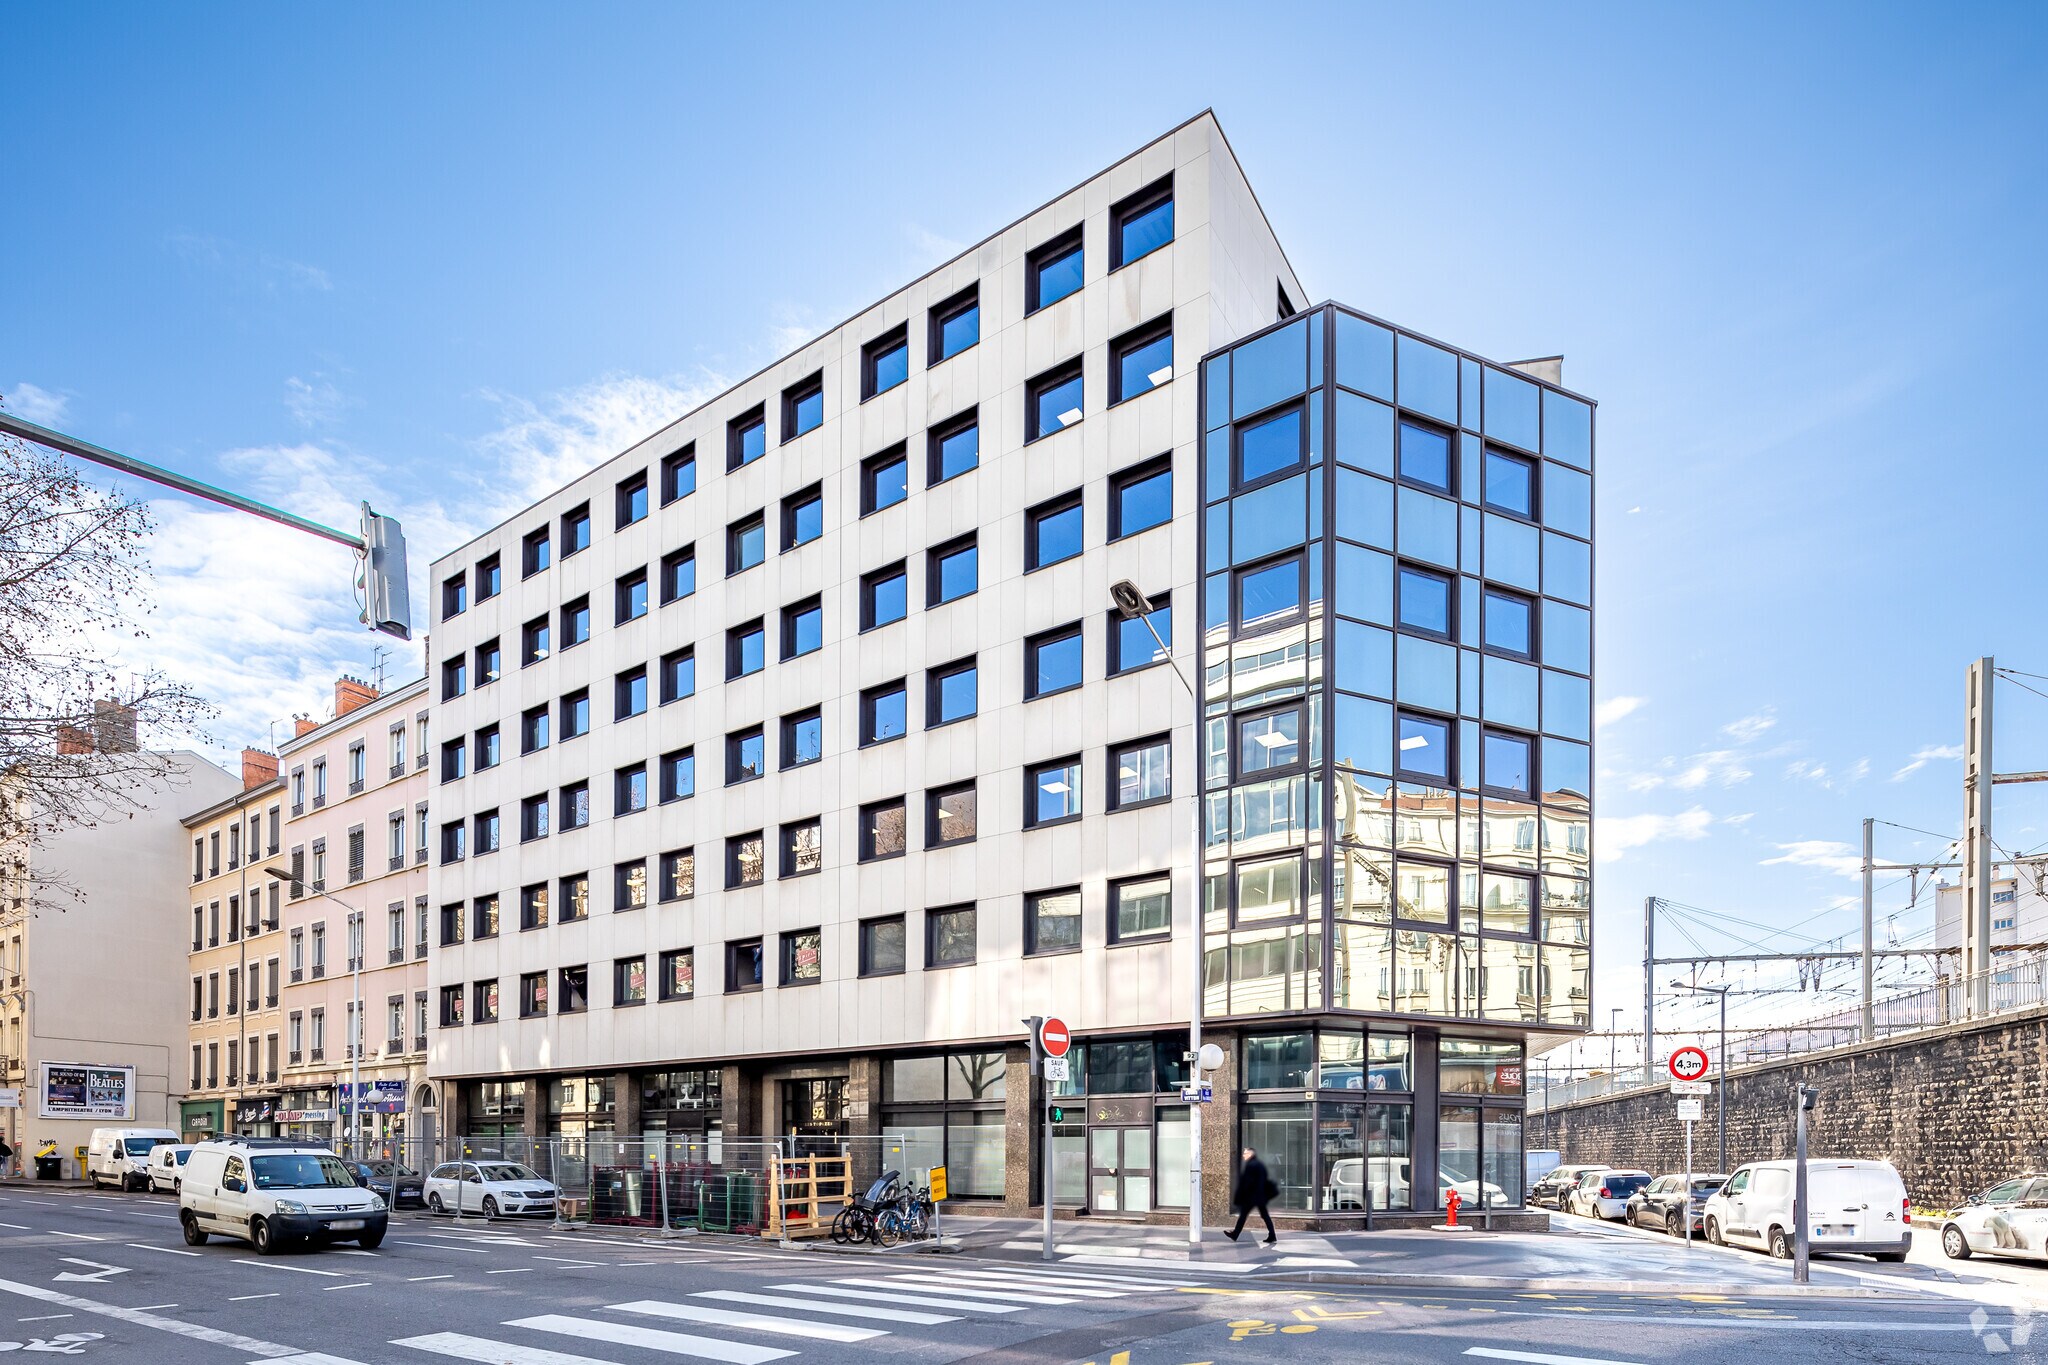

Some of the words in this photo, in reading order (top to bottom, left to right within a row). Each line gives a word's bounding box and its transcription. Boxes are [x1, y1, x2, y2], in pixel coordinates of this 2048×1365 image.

[1676, 1059, 1701, 1070] 4,3m
[90, 1073, 125, 1089] BEATLES
[812, 1107, 825, 1119] 92
